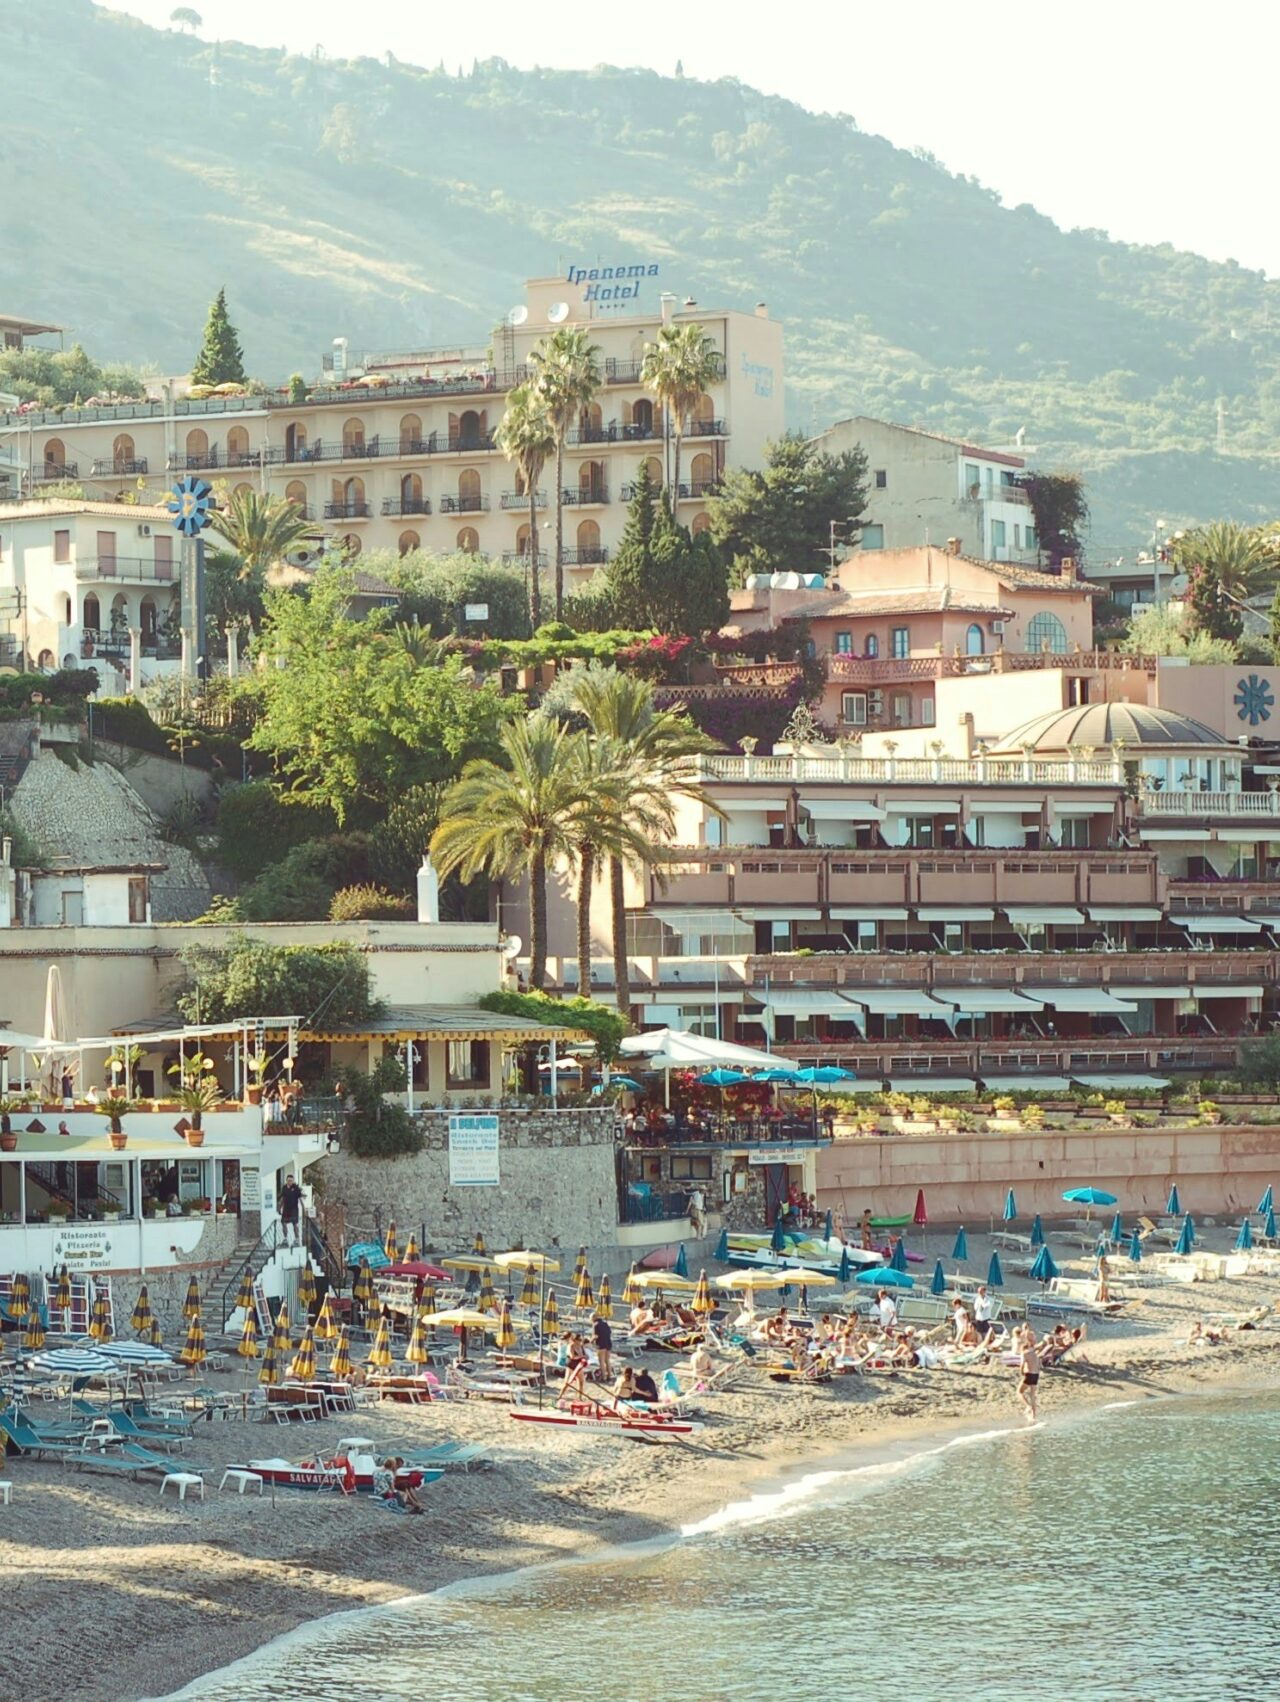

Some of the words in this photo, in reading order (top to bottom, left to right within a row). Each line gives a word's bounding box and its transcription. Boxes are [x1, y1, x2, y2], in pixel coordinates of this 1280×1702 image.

[567, 264, 659, 285] Ipanema
[584, 281, 640, 302] Hotel
[61, 1232, 107, 1240] Ristorante
[67, 1241, 101, 1249] Pizzeria
